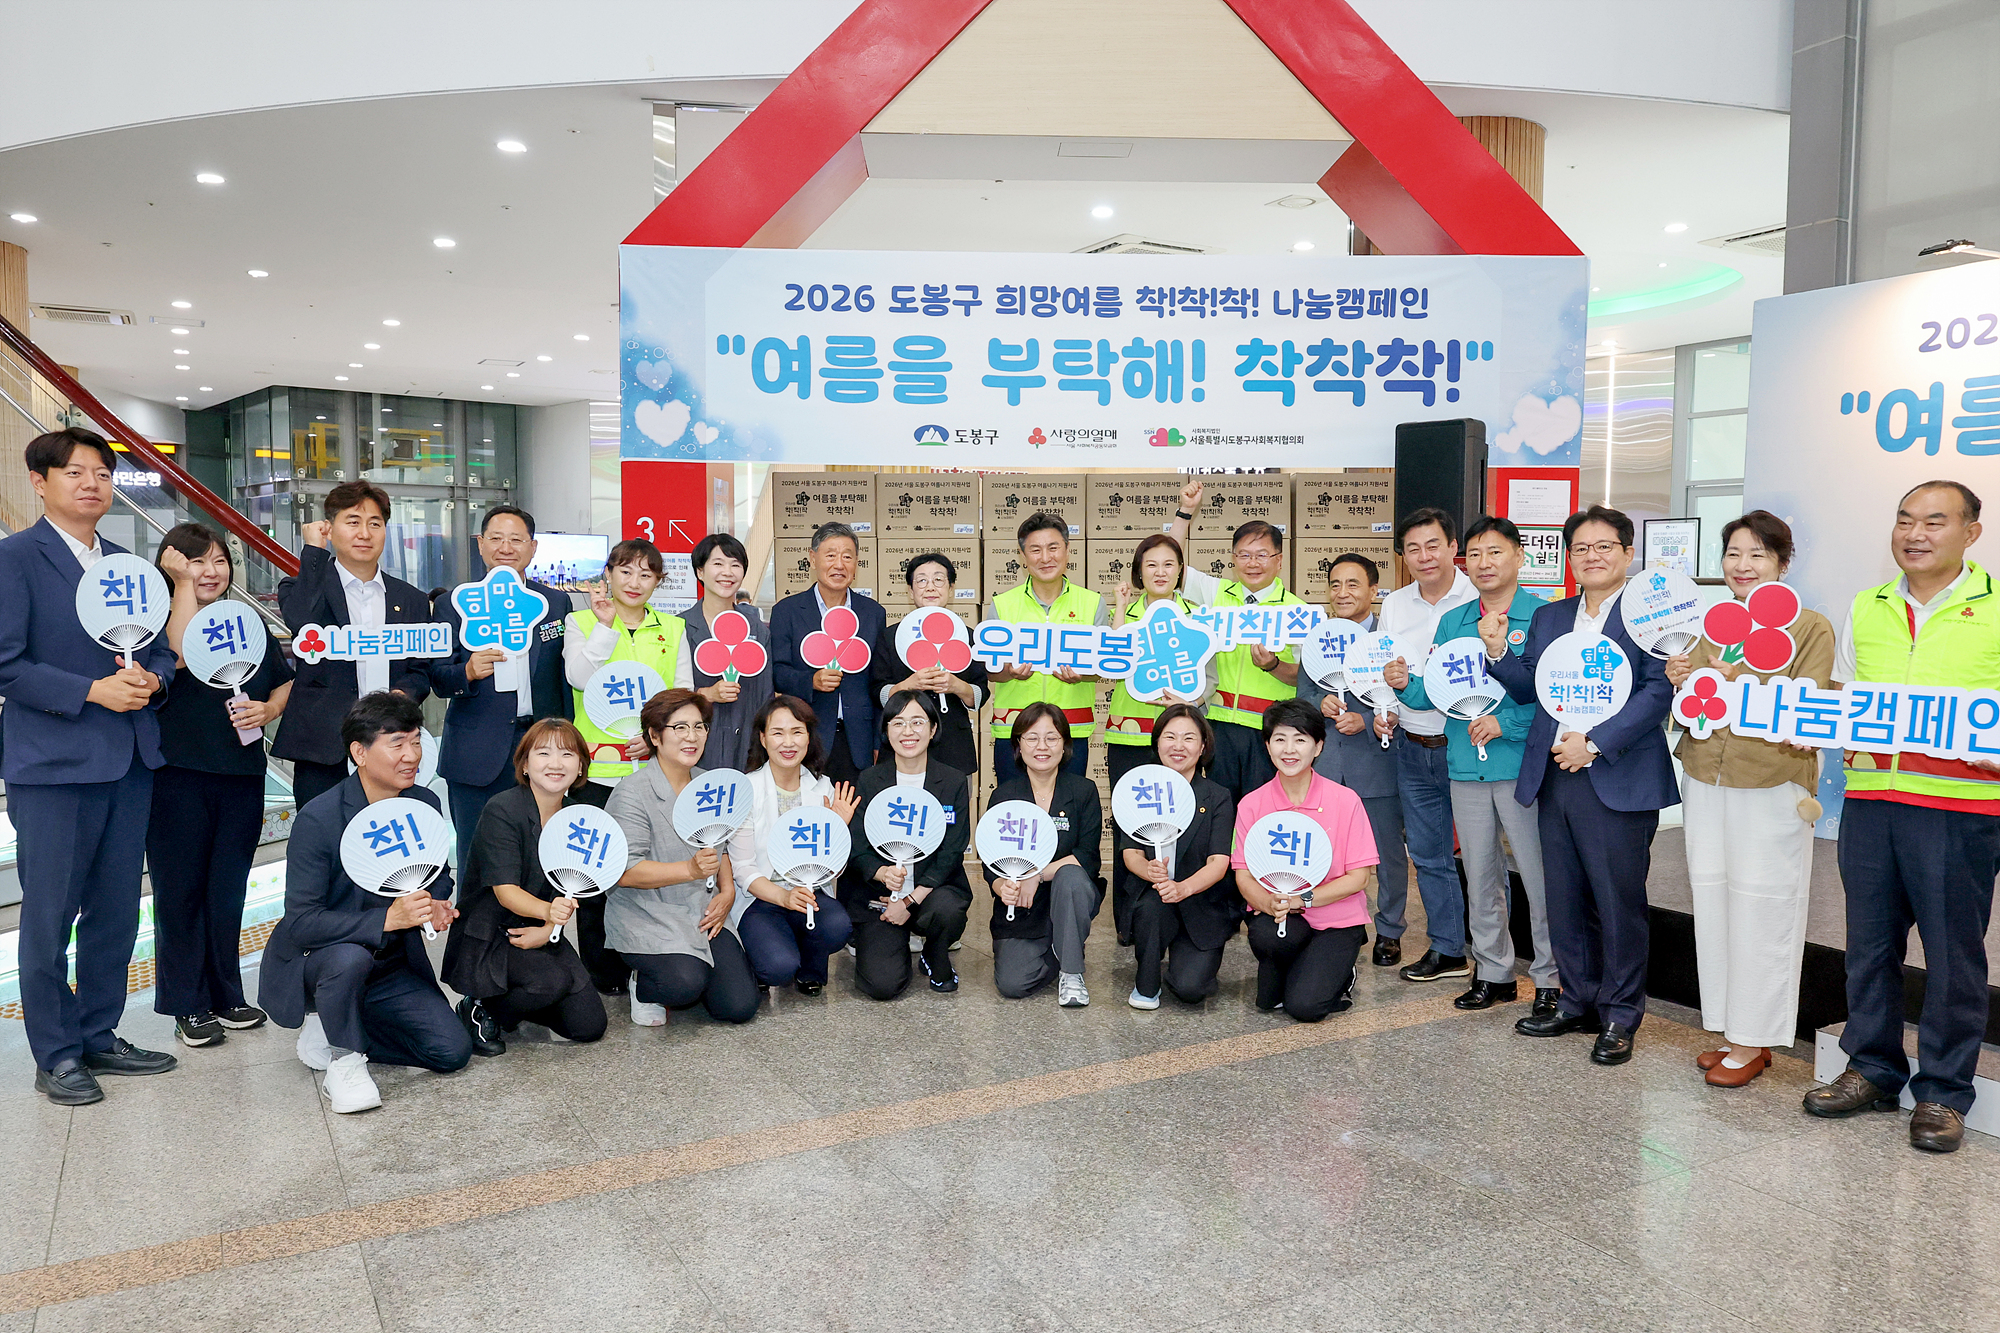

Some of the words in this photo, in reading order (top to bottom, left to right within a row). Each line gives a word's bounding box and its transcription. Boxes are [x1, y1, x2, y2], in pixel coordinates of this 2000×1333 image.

[784, 283, 875, 313] 2026
[888, 284, 982, 317] 도봉구
[995, 284, 1123, 319] 희망여름
[1136, 285, 1259, 319] 착!착!착!
[1273, 286, 1429, 320] 나눔캠페인
[716, 334, 953, 404] "여름을
[981, 336, 1205, 407] 부탁해!
[1234, 336, 1494, 407] 착착착!"
[954, 428, 999, 446] 도봉구
[1050, 428, 1118, 443] 사랑의열매
[1189, 435, 1304, 446] 서울특별시도봉구사회복지협의회
[813, 494, 838, 503] 여름을
[840, 494, 867, 503] 부탁해!
[916, 495, 940, 505] 여름을
[943, 495, 970, 504] 부탁해!
[1023, 496, 1047, 506] 여름을
[1050, 496, 1077, 505] 부탁해!
[1126, 495, 1150, 504] 여름을
[1153, 495, 1180, 504] 부탁해!
[1228, 496, 1253, 504] 여름을
[1255, 496, 1282, 504] 부탁해!
[1334, 495, 1359, 504] 여름을
[1361, 494, 1388, 503] 부탁해!
[826, 506, 854, 515] 착착착!
[930, 508, 957, 516] 착착착!
[1140, 507, 1167, 516] 착착착!
[1242, 508, 1269, 516] 착착착!
[1348, 507, 1375, 515] 착착착!
[636, 516, 655, 544] 3
[1520, 534, 1559, 550] 무더위
[857, 560, 869, 569] 해!
[952, 561, 971, 569] 탁해!
[1066, 562, 1077, 570] 해!
[1536, 551, 1558, 564] 쉼터
[100, 569, 148, 616] 착!
[466, 582, 518, 620] 희망
[202, 615, 248, 655] 착!
[478, 613, 528, 645] 여름
[330, 628, 448, 655] 나눔캠페인
[977, 626, 1133, 673] 우리도봉
[1584, 645, 1611, 665] 희망
[1146, 651, 1198, 688] 여름
[1442, 652, 1488, 689] 착!
[1550, 671, 1579, 679] 우리서울
[1588, 662, 1615, 680] 여름
[603, 674, 646, 710] 착!
[1549, 682, 1614, 704] 착!착!착
[1566, 706, 1604, 714] 나눔캠페인
[695, 783, 736, 817] 착!
[1132, 778, 1175, 815] 착!
[887, 796, 928, 837] 착!
[362, 812, 426, 858] 착!
[788, 818, 831, 857] 착!
[997, 812, 1038, 851] 착!
[566, 817, 611, 868] 착!
[1268, 823, 1312, 867] 착!
